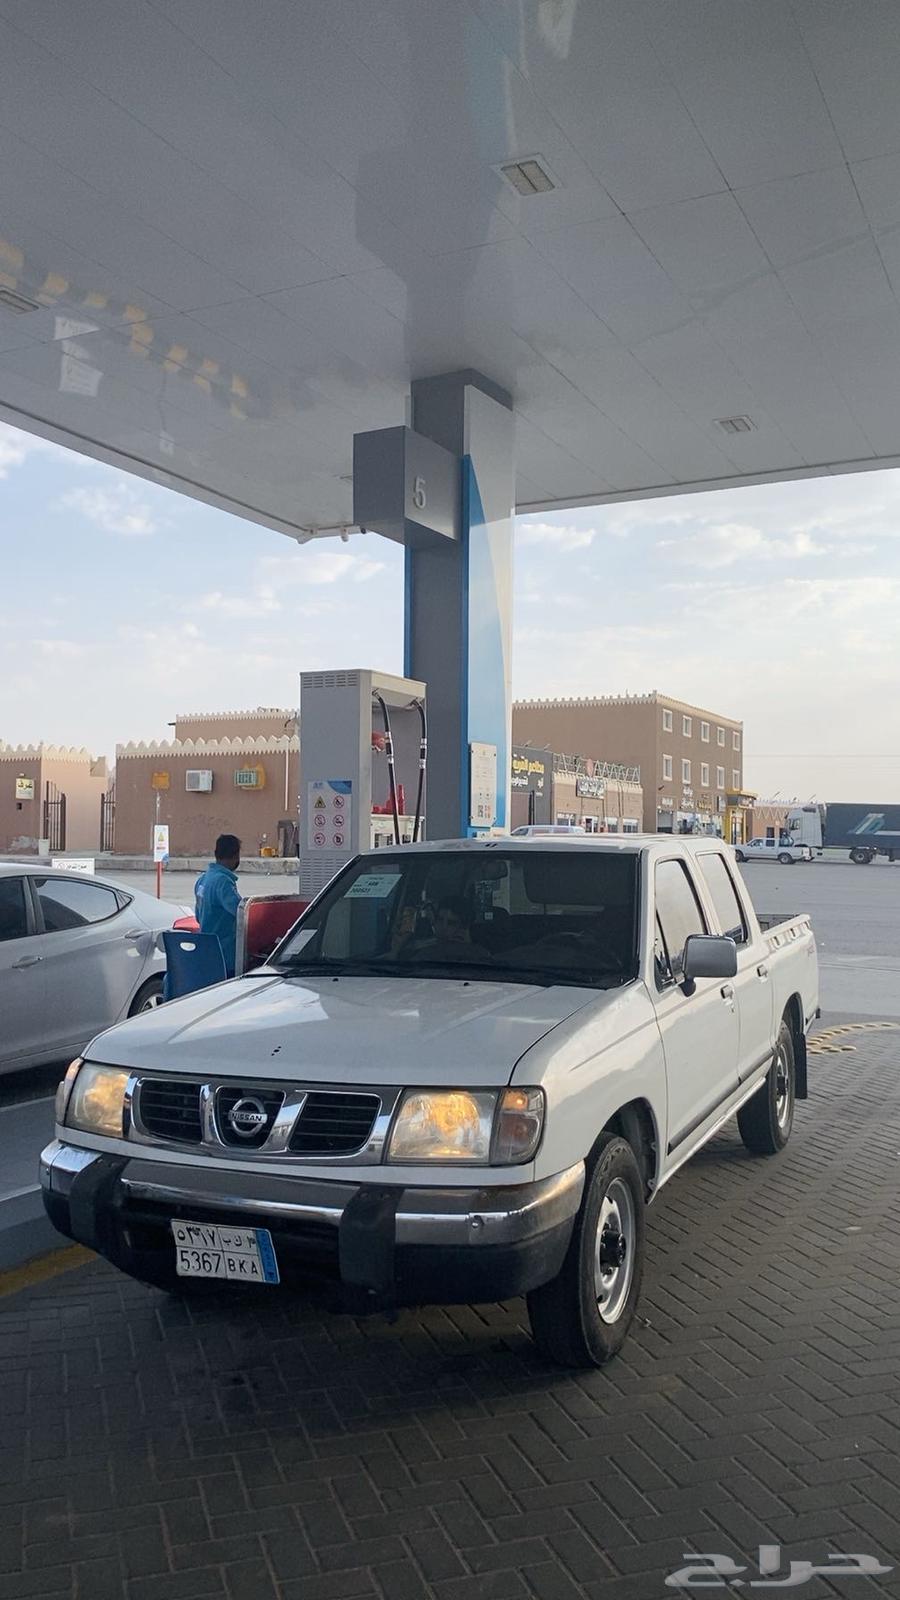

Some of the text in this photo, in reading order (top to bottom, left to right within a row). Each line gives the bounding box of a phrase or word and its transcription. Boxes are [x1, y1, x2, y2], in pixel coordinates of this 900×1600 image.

[414, 475, 426, 509] 5
[231, 1111, 263, 1122] NISSAN
[180, 1250, 259, 1274] 5367 BKA
